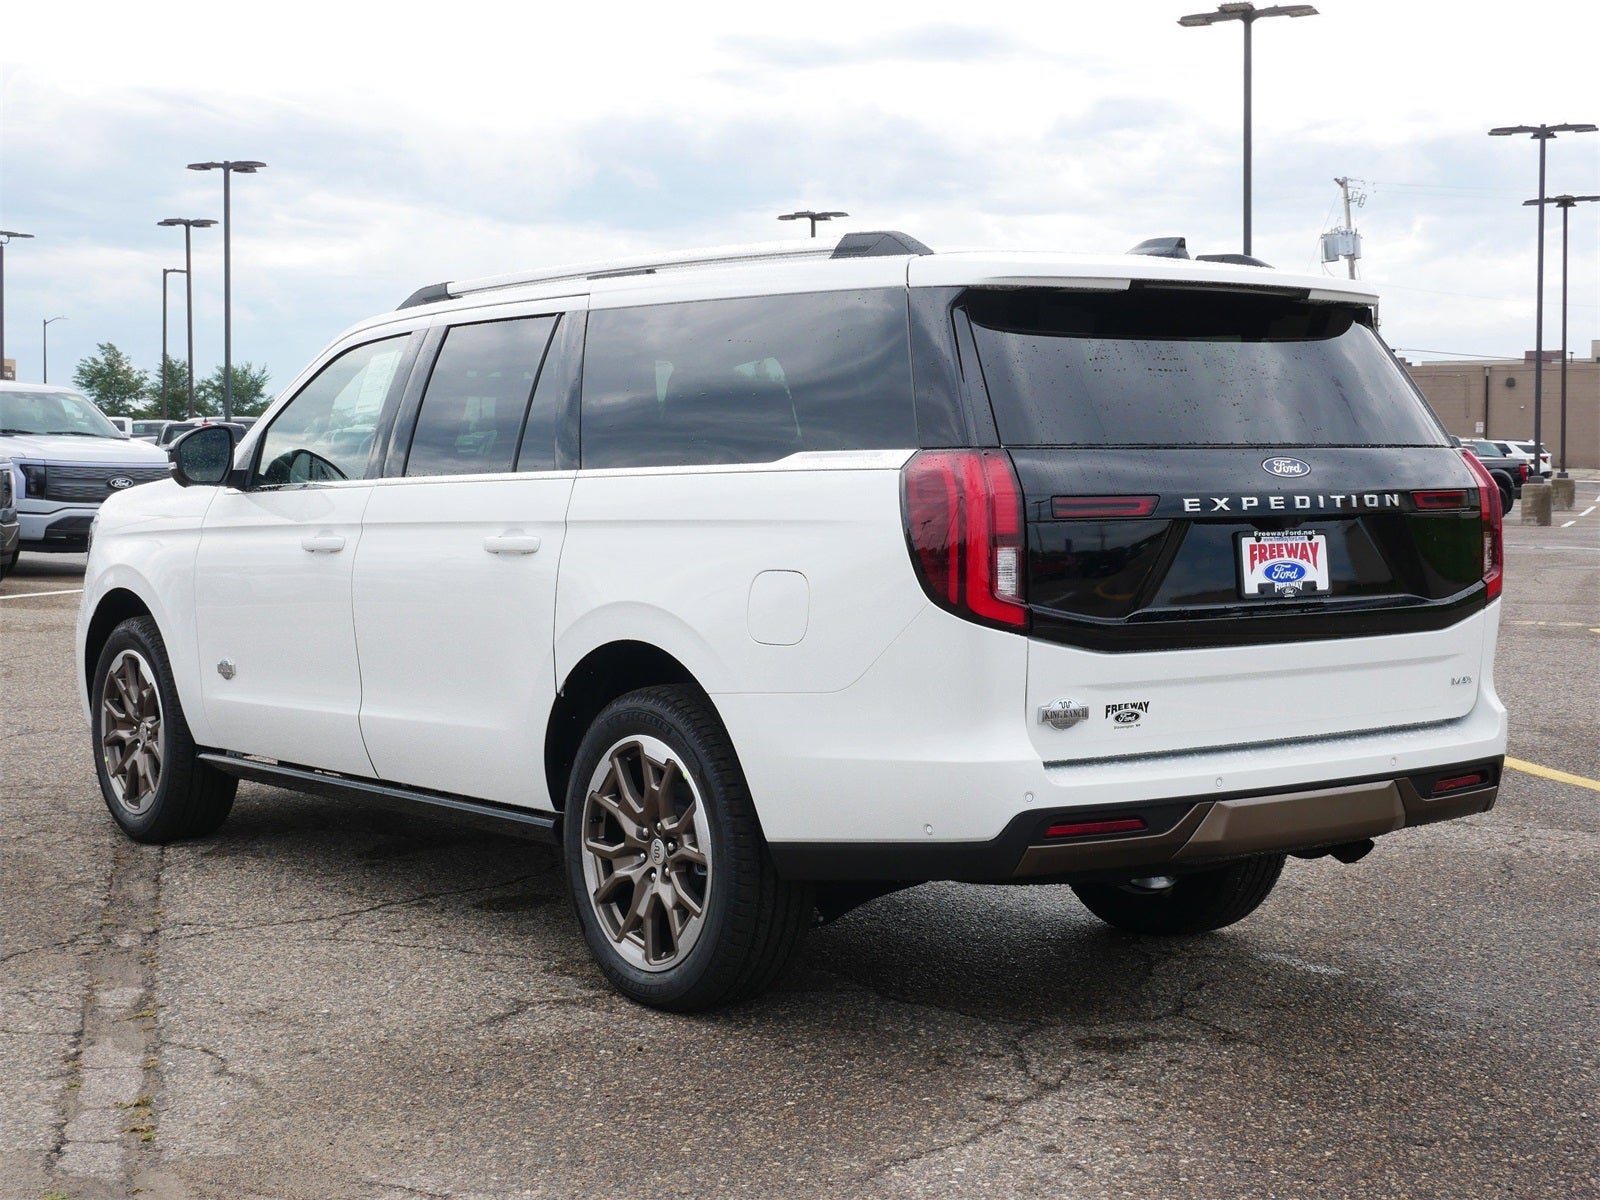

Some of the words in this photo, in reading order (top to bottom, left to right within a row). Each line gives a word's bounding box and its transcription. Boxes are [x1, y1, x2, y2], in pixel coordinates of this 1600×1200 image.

[1273, 459, 1303, 474] Ford
[1183, 493, 1400, 512] EXPEDITION
[1253, 529, 1317, 538] FreewayFord.net
[1249, 541, 1320, 576] FREEWAY
[1271, 563, 1300, 580] Ford
[1043, 708, 1063, 720] KING
[1063, 706, 1088, 719] RANCH
[1105, 701, 1150, 719] FREEWAY
[1116, 711, 1139, 723] Ford
